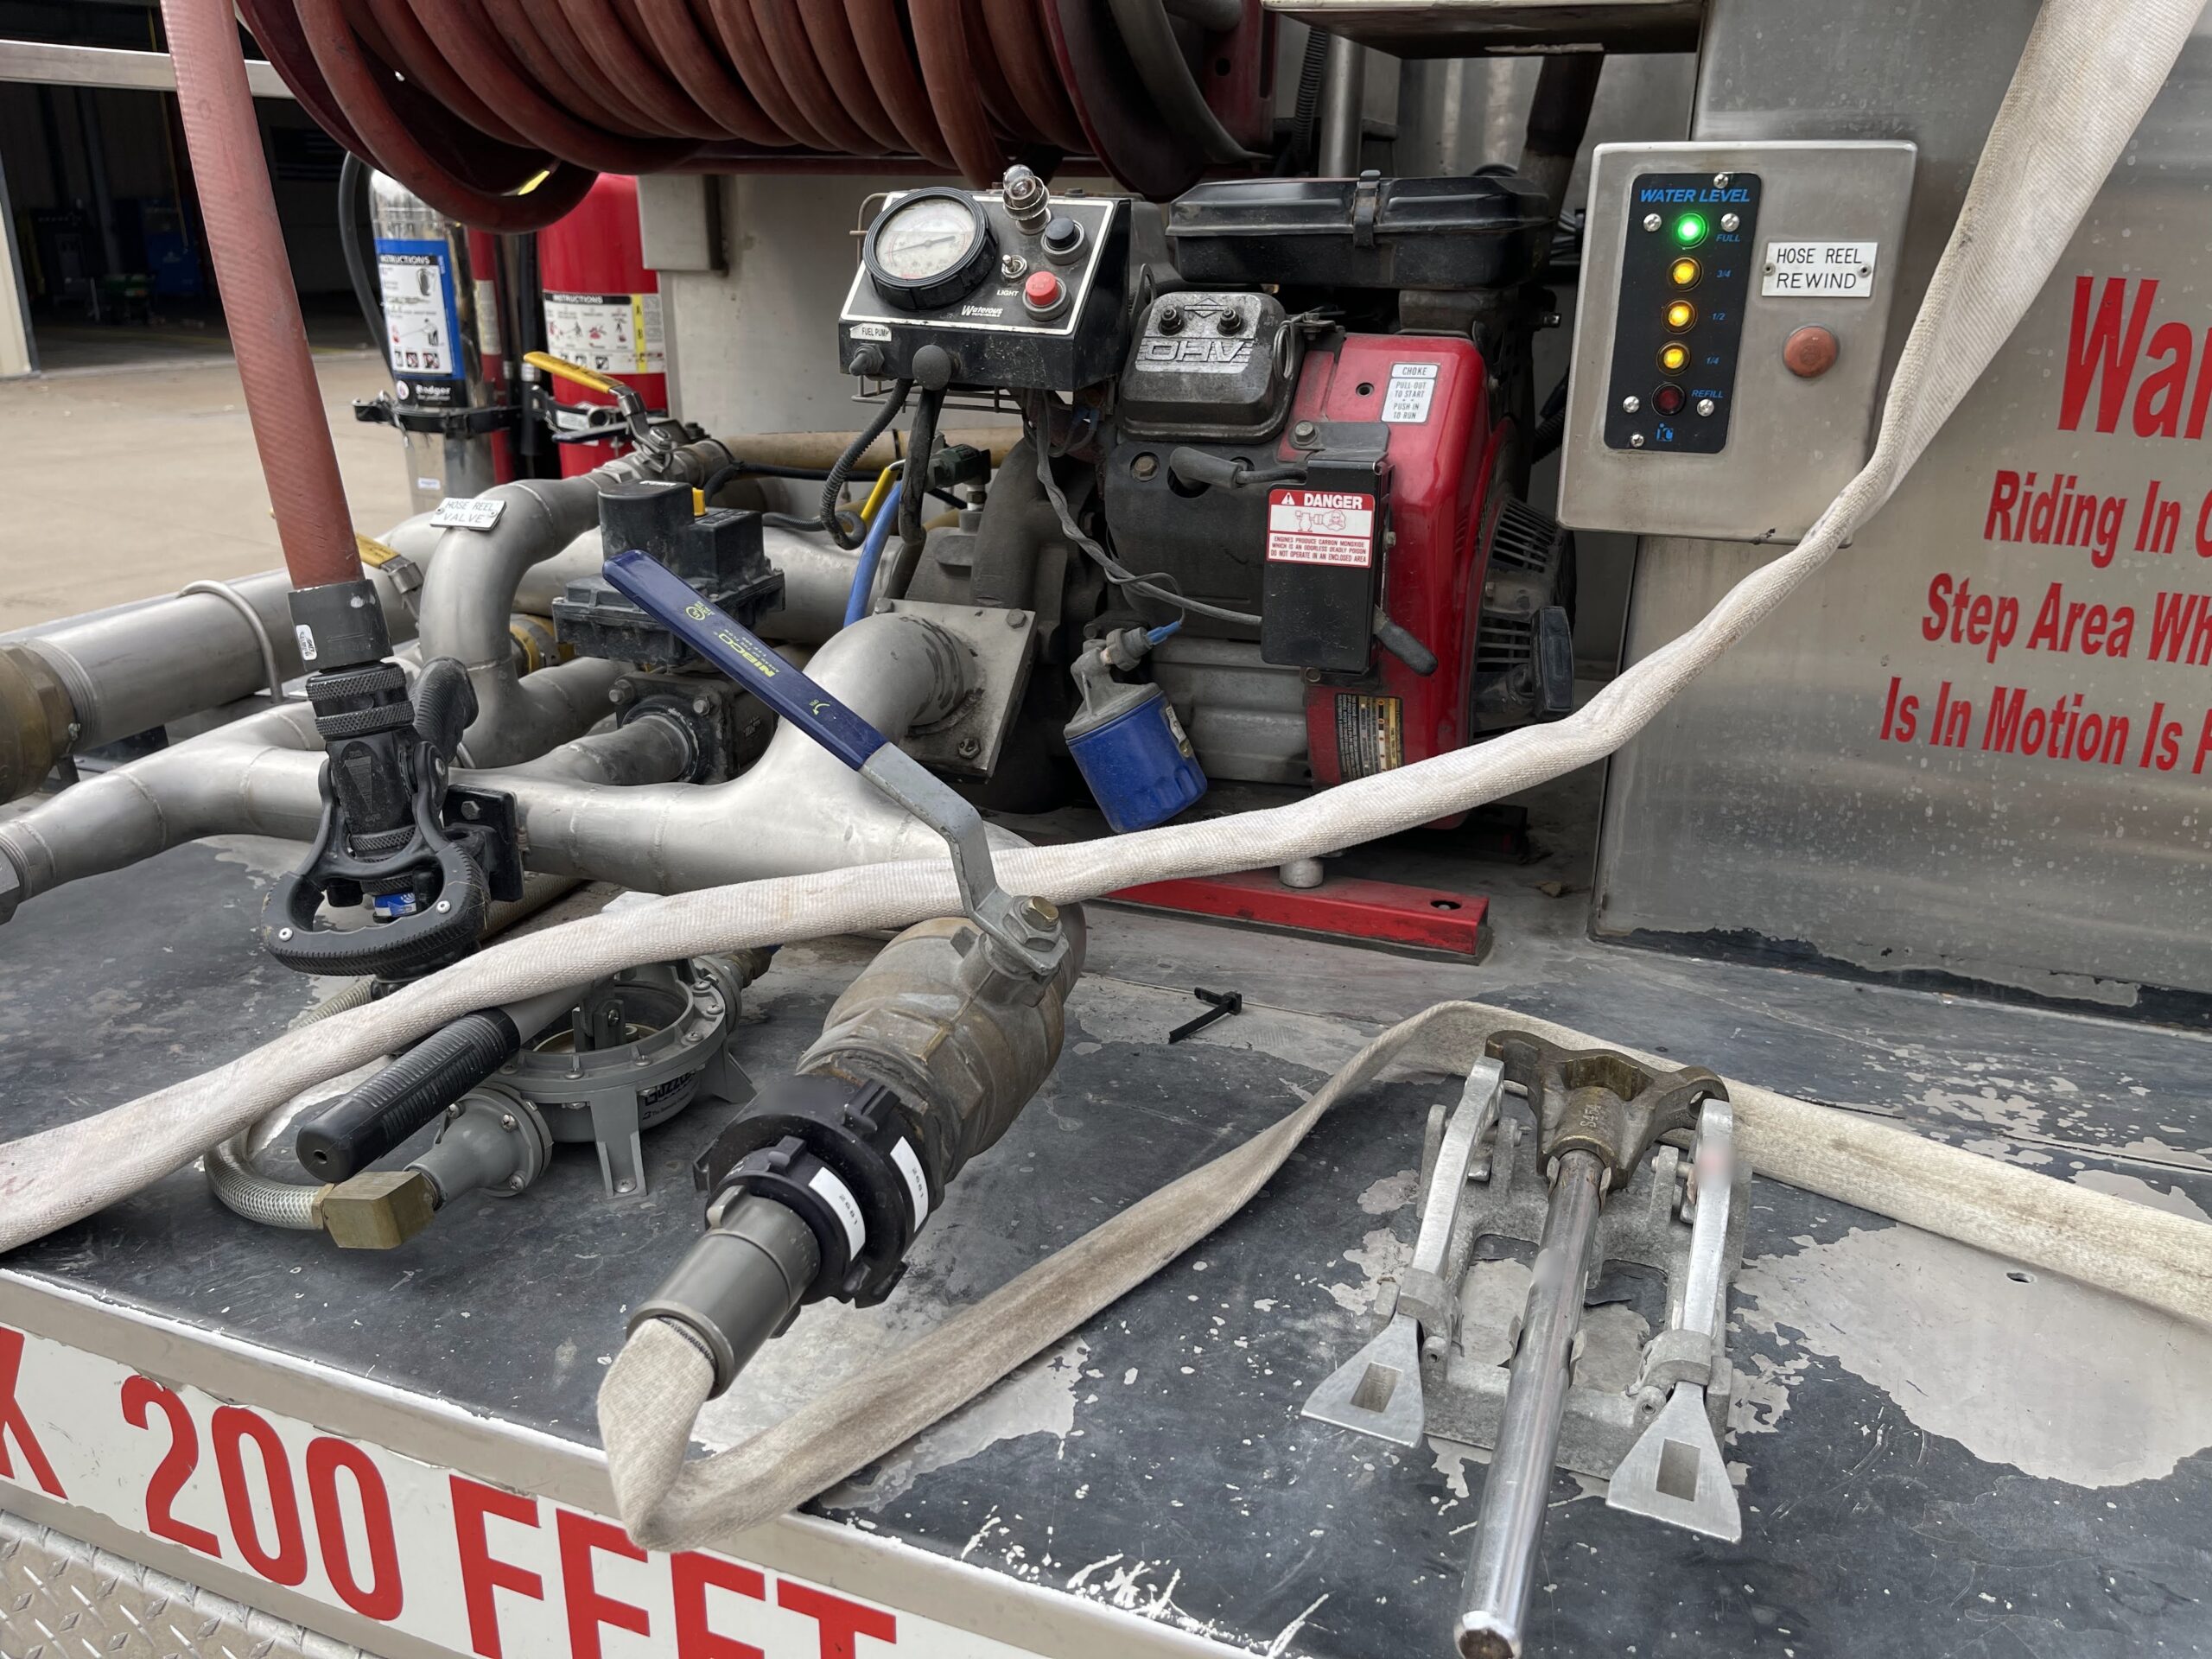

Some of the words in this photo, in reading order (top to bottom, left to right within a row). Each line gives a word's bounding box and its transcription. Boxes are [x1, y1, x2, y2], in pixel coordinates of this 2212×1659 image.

[1641, 189, 1696, 202] WATER
[1699, 189, 1750, 202] LEVEL
[1777, 247, 1816, 264] HOSE
[1825, 248, 1862, 264] REEL
[1717, 270, 1732, 278] 3/4
[1777, 272, 1856, 289] REWIND
[961, 305, 1003, 316] Waterous
[1712, 312, 1726, 321] 1/2
[861, 327, 874, 336] FUEL
[1707, 356, 1719, 365] 1/4
[1402, 366, 1427, 376] CHOKE
[1395, 390, 1402, 398] TO
[1404, 390, 1425, 398] START
[1691, 389, 1724, 398] REFILL
[1402, 411, 1416, 420] RUN
[445, 500, 469, 510] HOSE
[472, 502, 493, 512] REEL
[1303, 493, 1363, 510] DANGER
[443, 513, 484, 524] VALVE
[1984, 469, 2127, 569] Riding
[2134, 480, 2181, 554] In
[1290, 550, 1310, 559] OPERATE
[1923, 573, 2018, 664] Step
[2027, 582, 2135, 658] Area
[718, 632, 776, 677] NIBCO
[1879, 677, 1920, 744] Is
[1929, 681, 1972, 748] In
[1981, 685, 2129, 765] Motion
[2139, 702, 2183, 772] Is
[120, 1375, 404, 1621] 200
